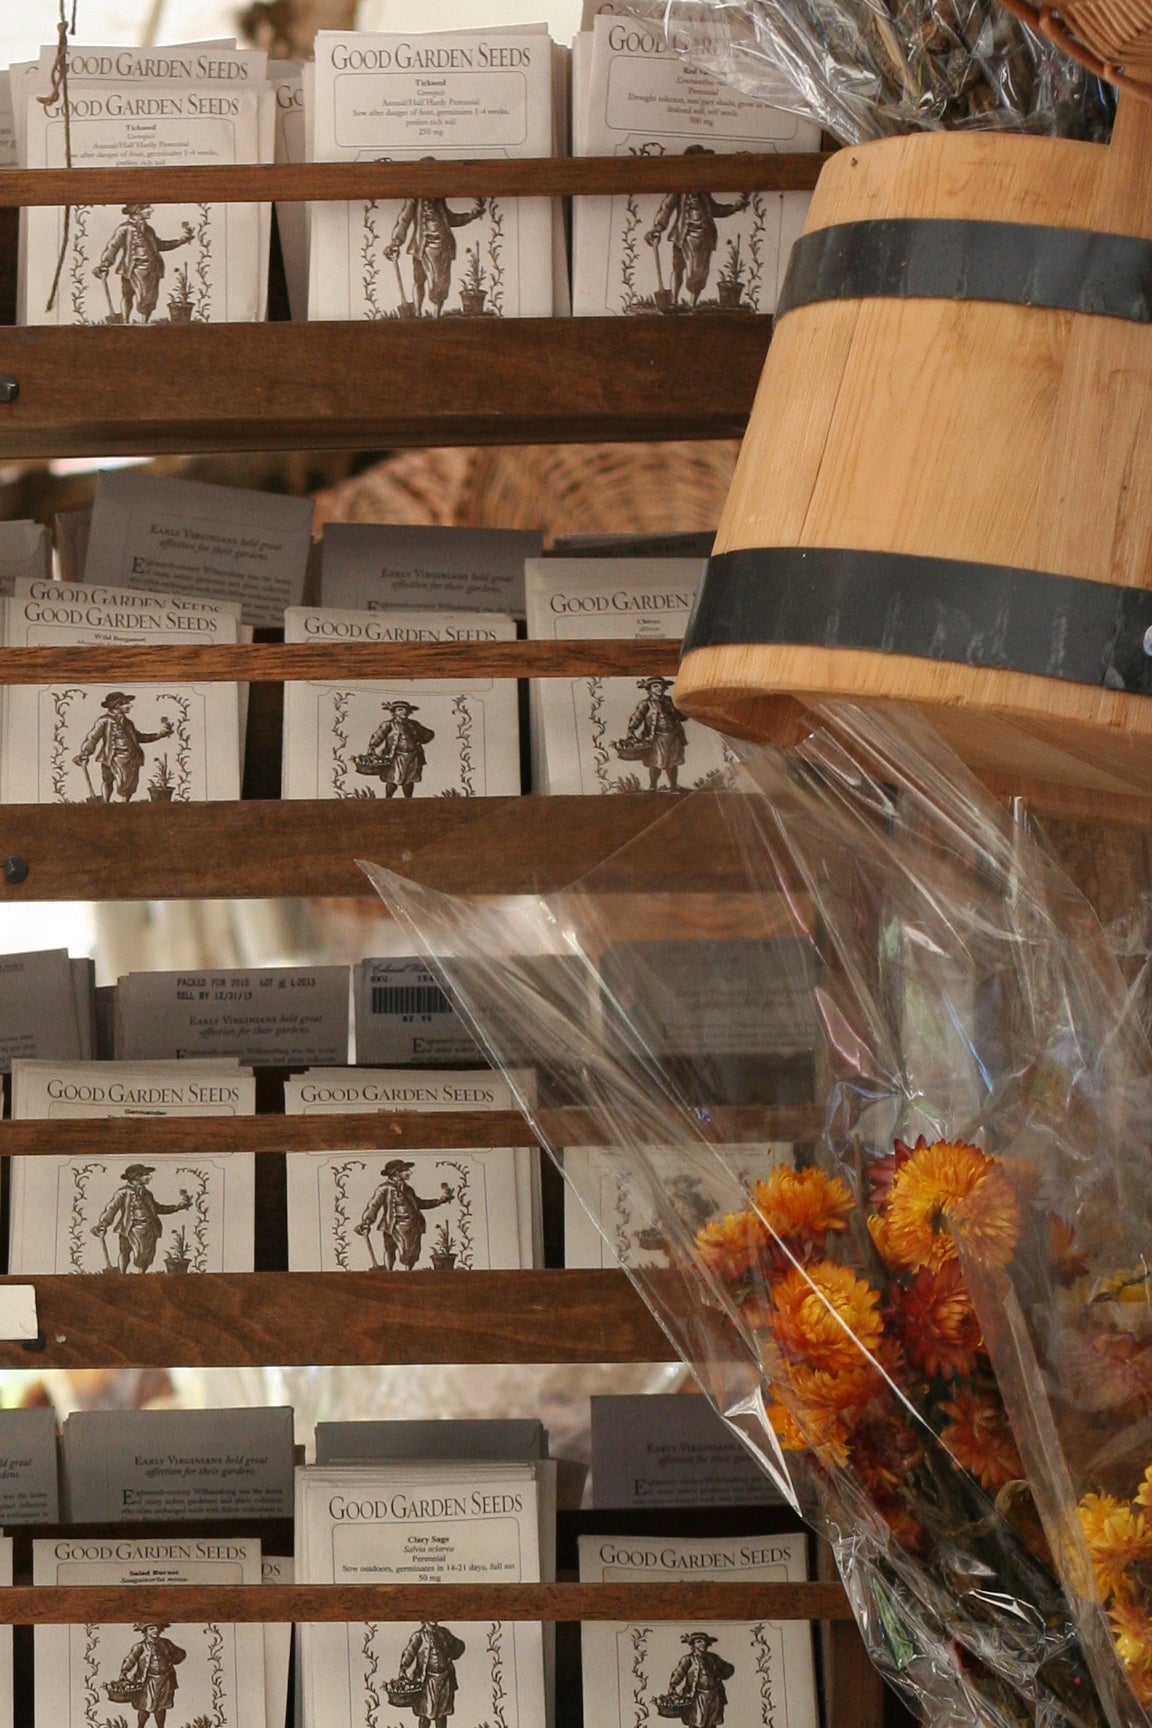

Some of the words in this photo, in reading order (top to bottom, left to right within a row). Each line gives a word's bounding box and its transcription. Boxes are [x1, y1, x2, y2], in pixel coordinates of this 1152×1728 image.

[116, 52, 193, 78] GARDEN
[197, 55, 249, 80] SEEDS
[331, 44, 391, 70] GOOD
[394, 42, 473, 69] GARDEN
[478, 42, 531, 67] SEEDS
[106, 94, 189, 116] GARDEN
[188, 94, 240, 116] SEEDS
[550, 593, 609, 614] GOOD
[612, 592, 689, 612] GARDEN
[24, 603, 82, 624] GOOD
[86, 606, 162, 630] GARDEN
[166, 611, 217, 631] SEEDS
[304, 616, 362, 638] GOOD
[365, 623, 440, 641] GARDEN
[446, 626, 496, 641] SEEDS
[47, 1080, 105, 1100] GOOD
[108, 1084, 184, 1104] GARDEN
[188, 1084, 240, 1103] SEEDS
[300, 1085, 358, 1103] GOOD
[362, 1085, 438, 1103] GARDEN
[443, 1085, 494, 1103] SEEDS
[329, 1496, 388, 1520] GOOD
[391, 1494, 467, 1518] GARDEN
[471, 1490, 522, 1515] SEEDS
[54, 1542, 112, 1560] GOOD
[116, 1544, 190, 1560] GARDEN
[195, 1542, 247, 1560] SEEDS
[600, 1544, 657, 1565] GOOD
[660, 1550, 736, 1568] GARDEN
[740, 1546, 792, 1564] SEEDS
